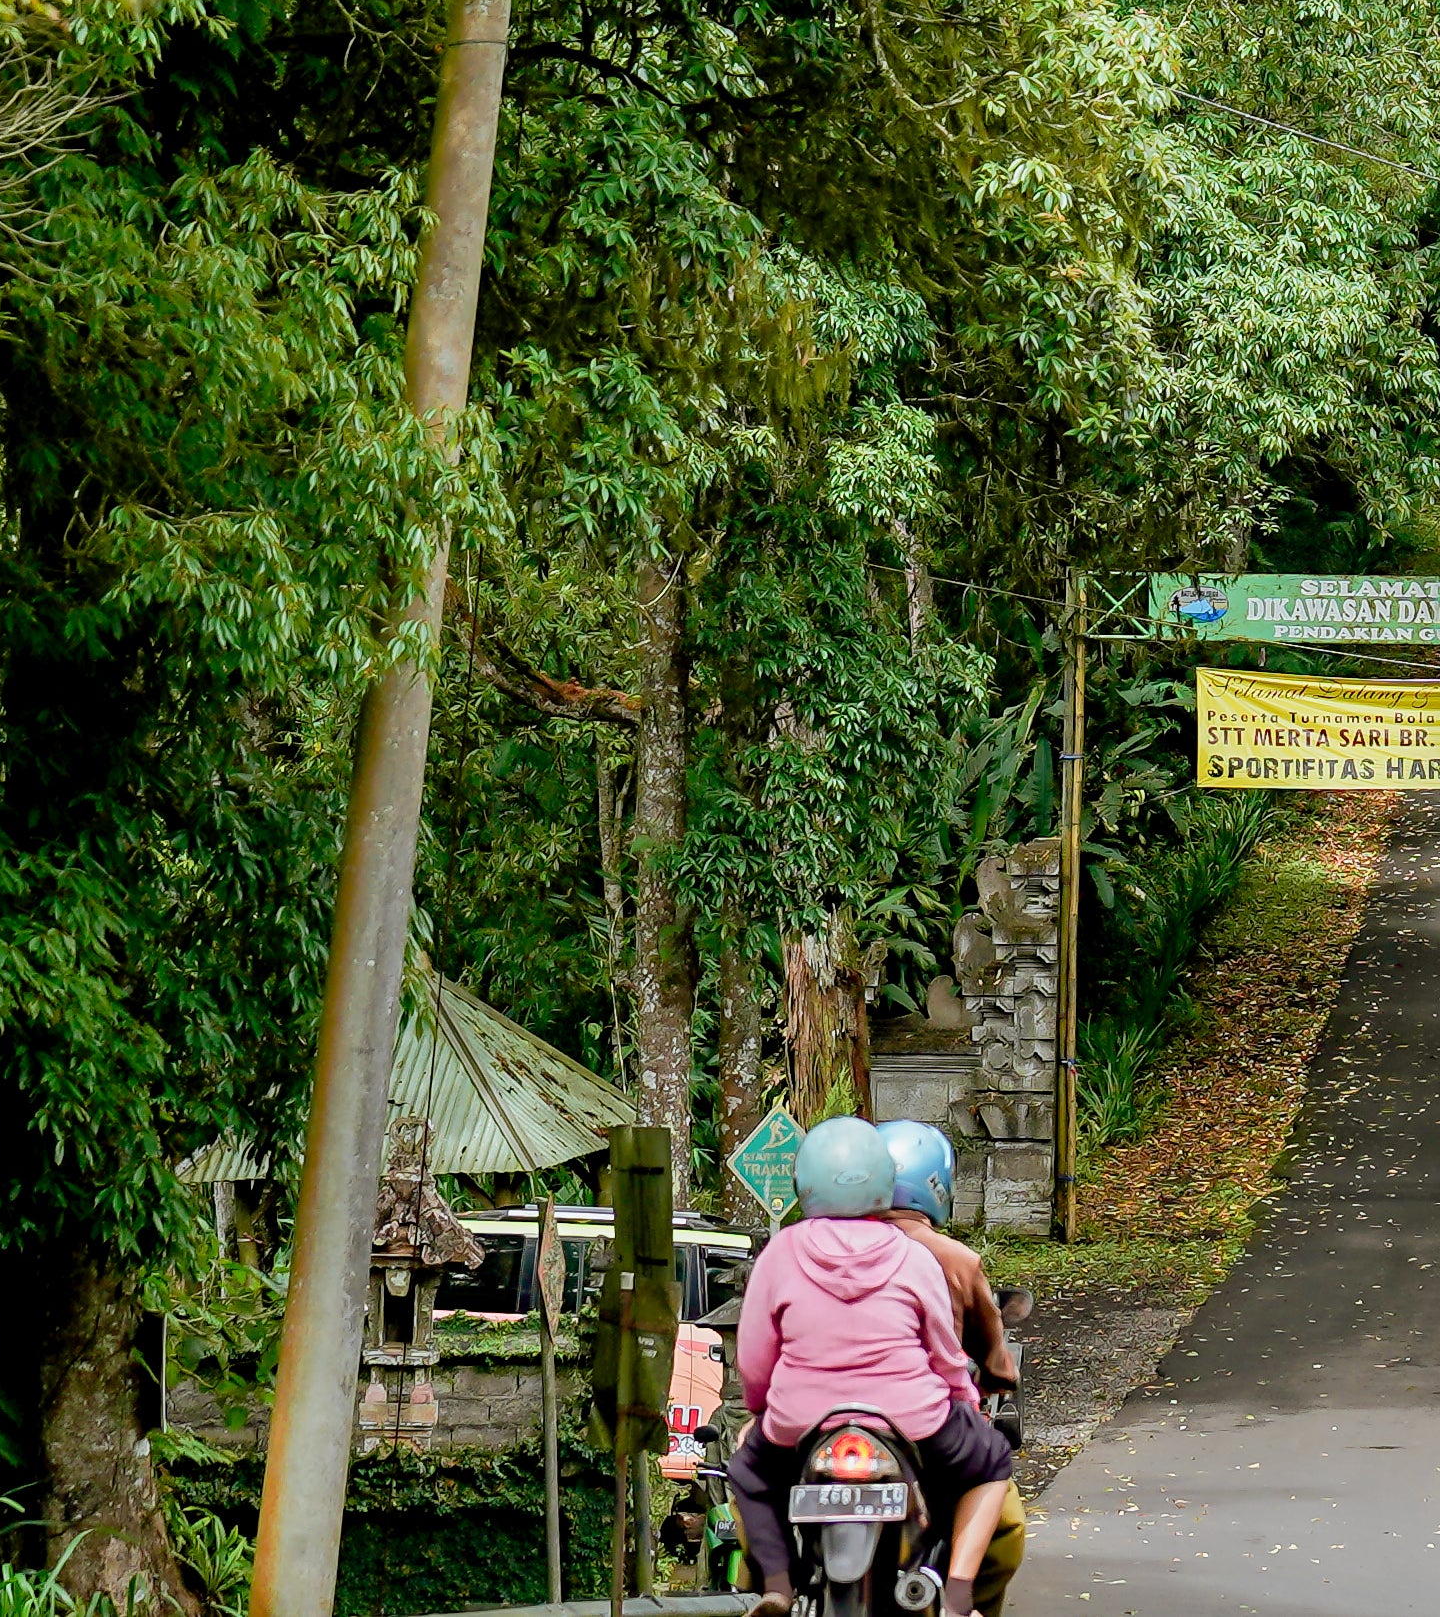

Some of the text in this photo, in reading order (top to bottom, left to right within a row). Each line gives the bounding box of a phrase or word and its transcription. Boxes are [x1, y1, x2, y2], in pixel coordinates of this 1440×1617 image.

[1246, 597, 1393, 623] DIKAWASAN
[1274, 625, 1412, 641] PENDAKIAN
[1207, 674, 1309, 700] Selamat
[1313, 679, 1406, 708] Datang
[1207, 710, 1278, 724] Peserta
[1289, 711, 1384, 724] Turnamen
[1394, 712, 1435, 724] Bola
[1207, 726, 1246, 746] STT
[1253, 728, 1331, 748] MERTA
[1339, 728, 1390, 748] SARI
[1399, 728, 1436, 747] BR.
[1207, 755, 1376, 780] SPORTIFITAS
[743, 1163, 793, 1177] TRAKK
